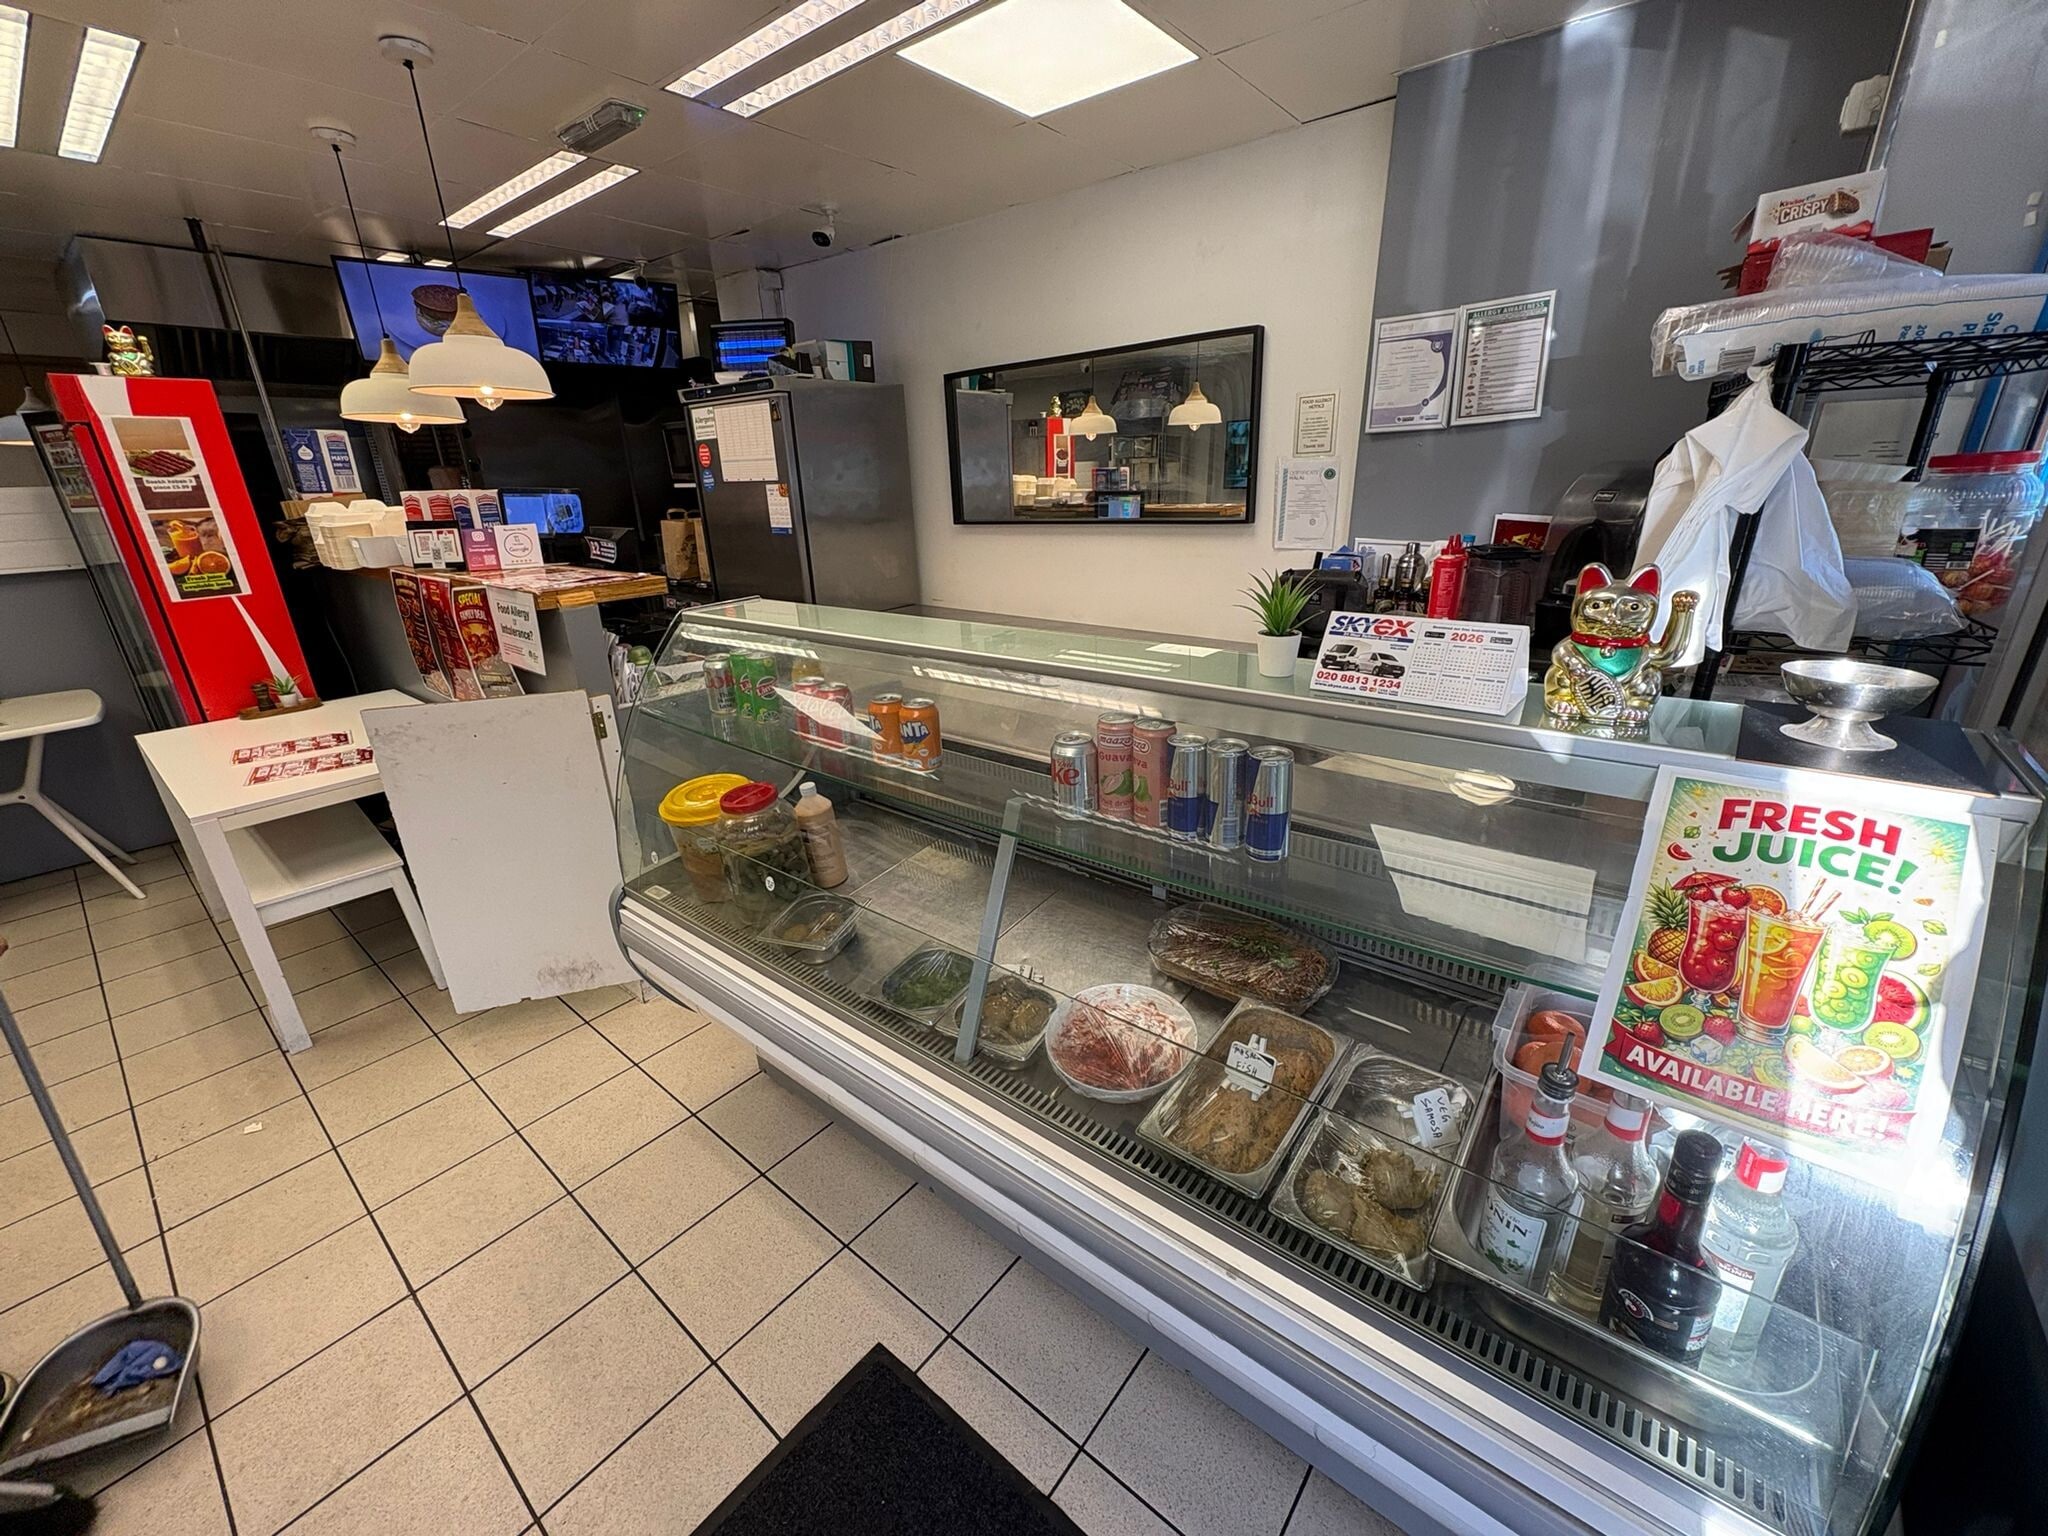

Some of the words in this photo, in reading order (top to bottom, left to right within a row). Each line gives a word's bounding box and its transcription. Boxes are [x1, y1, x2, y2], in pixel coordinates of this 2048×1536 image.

[1780, 199, 1829, 223] CRISPY
[1473, 307, 1501, 319] ALLERGY
[1503, 301, 1545, 314] AWARENESS
[457, 592, 483, 608] SPECIAL
[496, 602, 509, 615] Food
[510, 604, 530, 622] Allergy
[1450, 632, 1485, 644] 2026
[1316, 670, 1338, 681] 020
[1339, 673, 1369, 685] 8813
[1371, 678, 1402, 690] 1234
[1099, 751, 1134, 763] Guava
[1051, 759, 1080, 787] ke
[1718, 798, 1902, 856] FRESH
[1712, 832, 1919, 895] JUICE!
[1626, 1045, 1779, 1112] AVAILABLE
[1786, 1099, 1893, 1140] HERE!
[1422, 1098, 1443, 1139] SAMOSA
[1436, 1095, 1452, 1124] VEG
[1487, 1196, 1529, 1238] ONIN
